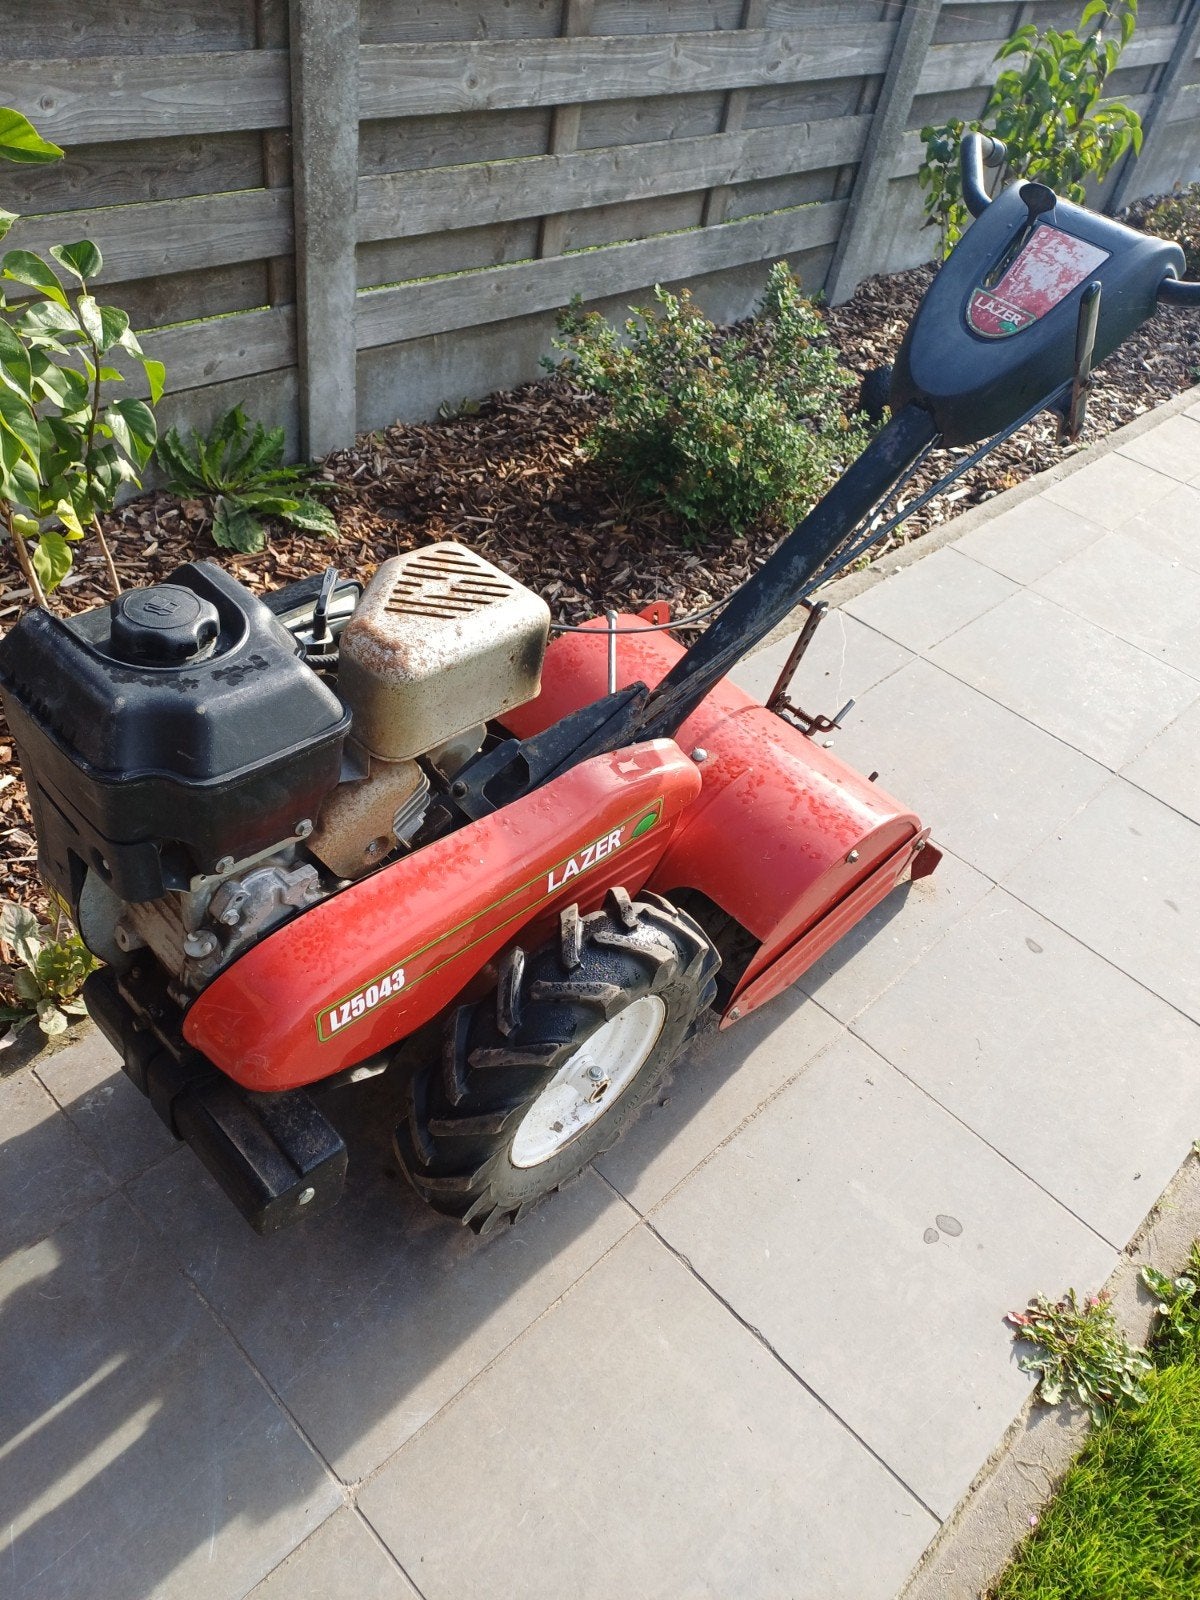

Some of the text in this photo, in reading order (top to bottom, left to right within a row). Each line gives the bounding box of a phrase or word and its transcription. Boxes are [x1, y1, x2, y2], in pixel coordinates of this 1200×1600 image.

[974, 296, 1023, 326] LAZER
[547, 828, 621, 894] LAZER
[329, 968, 406, 1032] LZ5043
